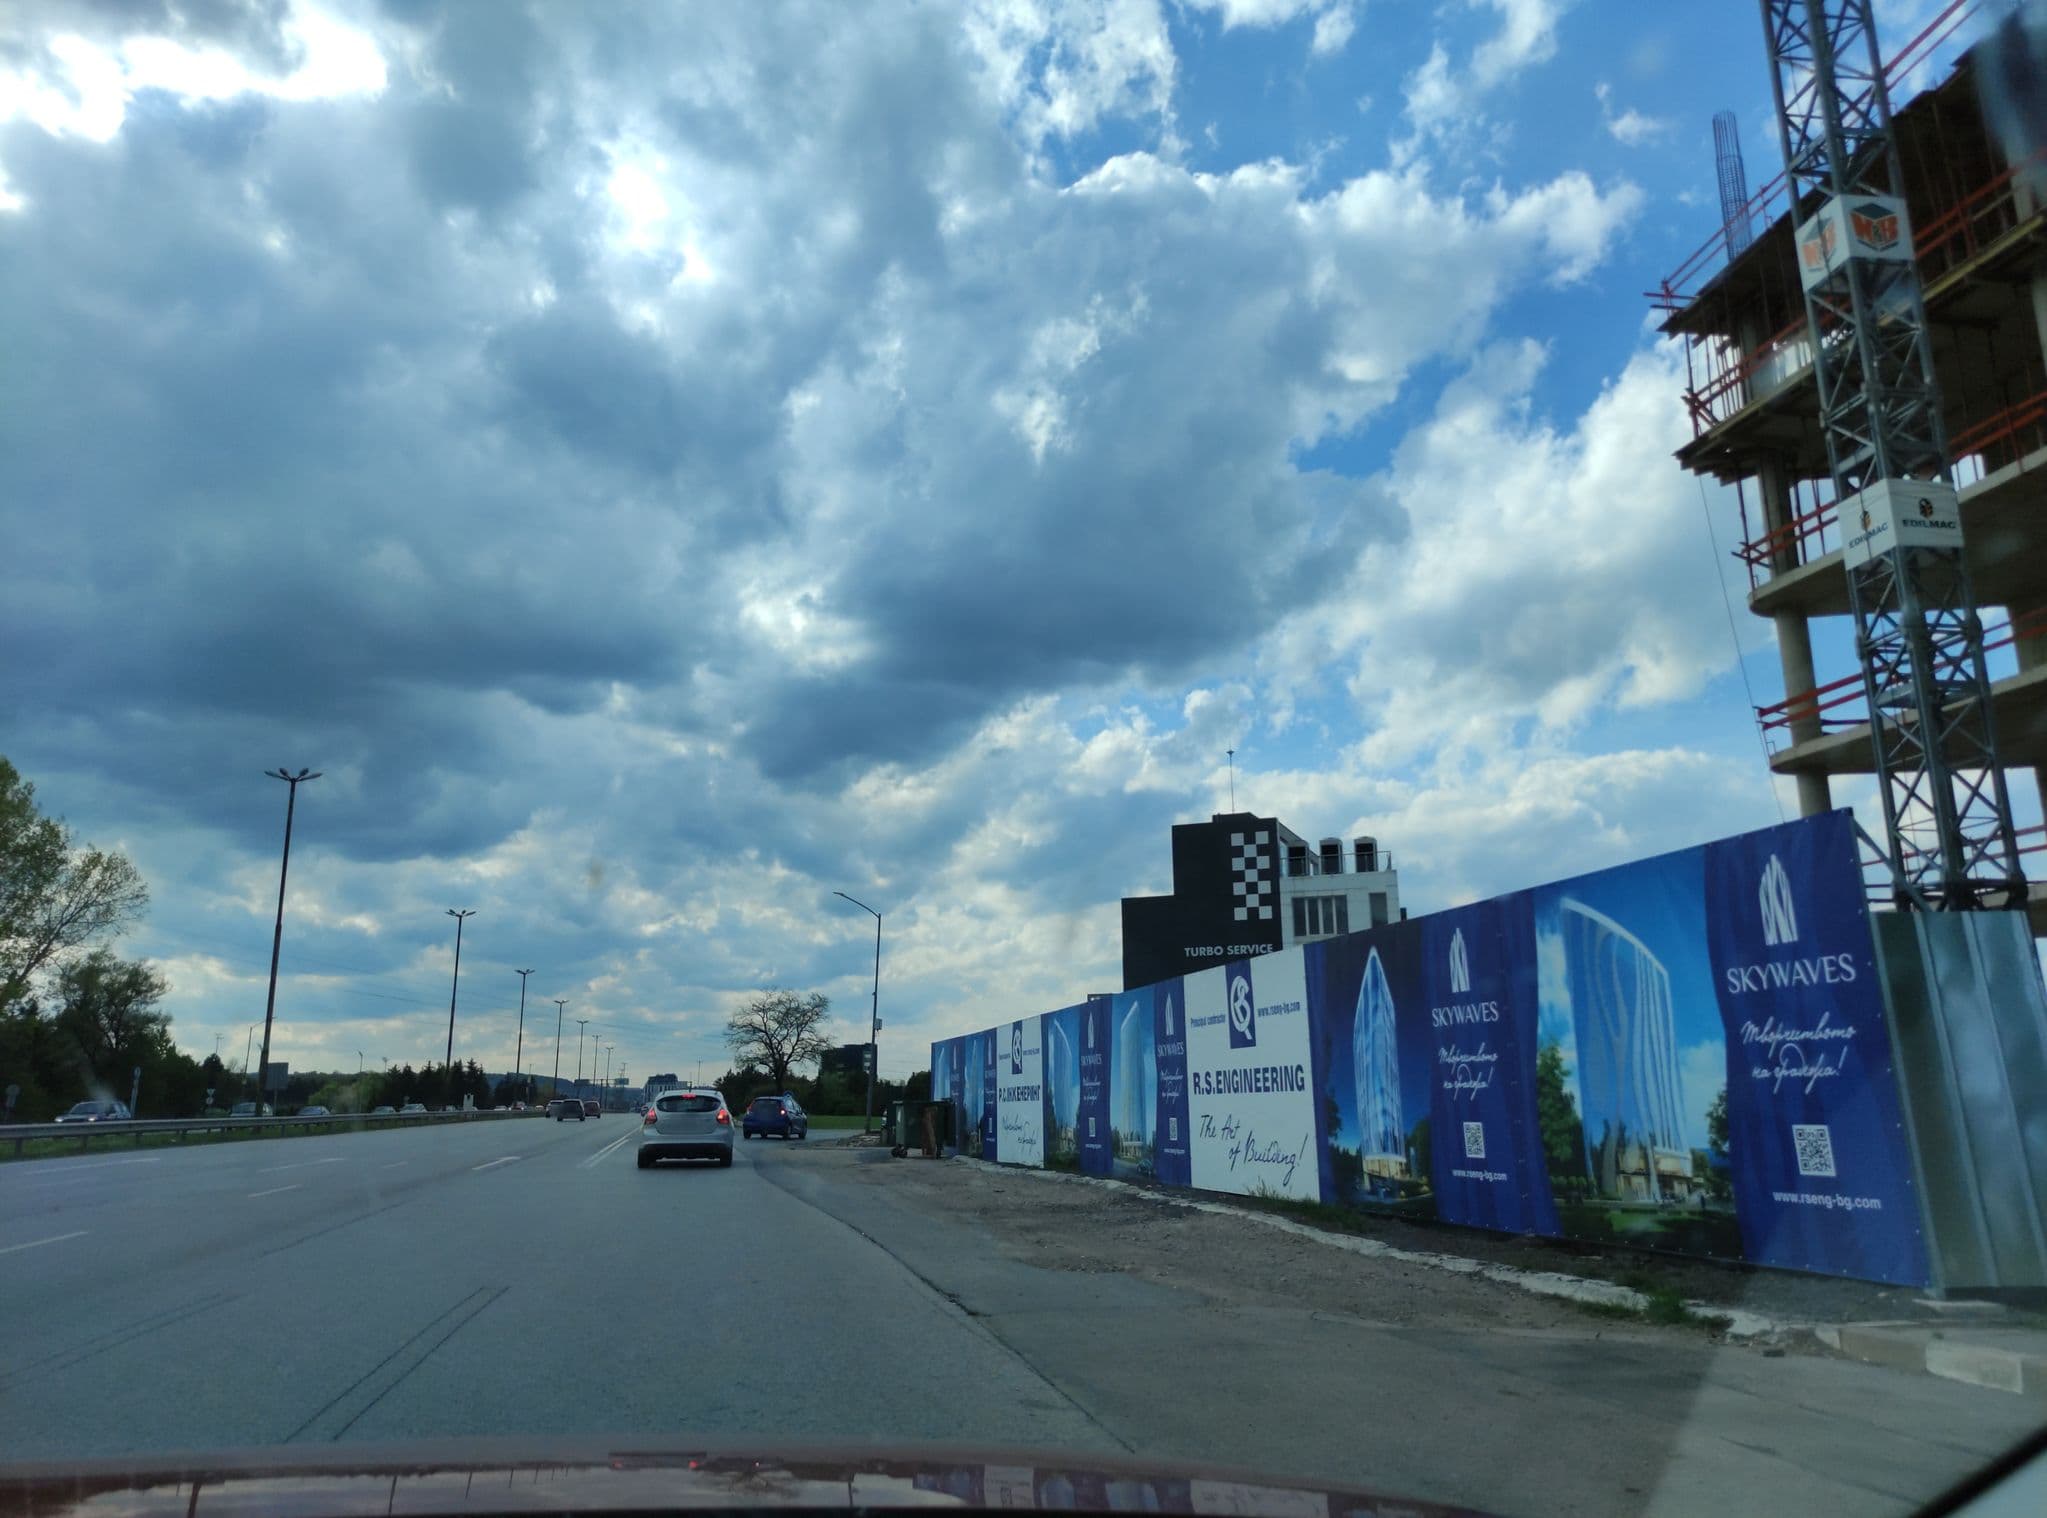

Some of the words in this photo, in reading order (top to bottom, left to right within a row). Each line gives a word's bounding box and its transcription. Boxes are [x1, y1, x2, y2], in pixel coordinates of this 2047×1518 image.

[1902, 519, 1957, 530] EDILMAC
[1184, 945, 1224, 957] TURBO
[1227, 943, 1274, 955] SERVICE
[1727, 953, 1857, 994] SKYWAVES
[1432, 1001, 1499, 1028] SKYWAVES
[1193, 1064, 1305, 1096] R.S.ENGINEERING
[1200, 1114, 1217, 1138] The
[1221, 1113, 1241, 1141] Art
[1228, 1141, 1241, 1172] of
[1243, 1129, 1309, 1187] Building!
[1773, 1191, 1882, 1210] www.rseng-bg.com
